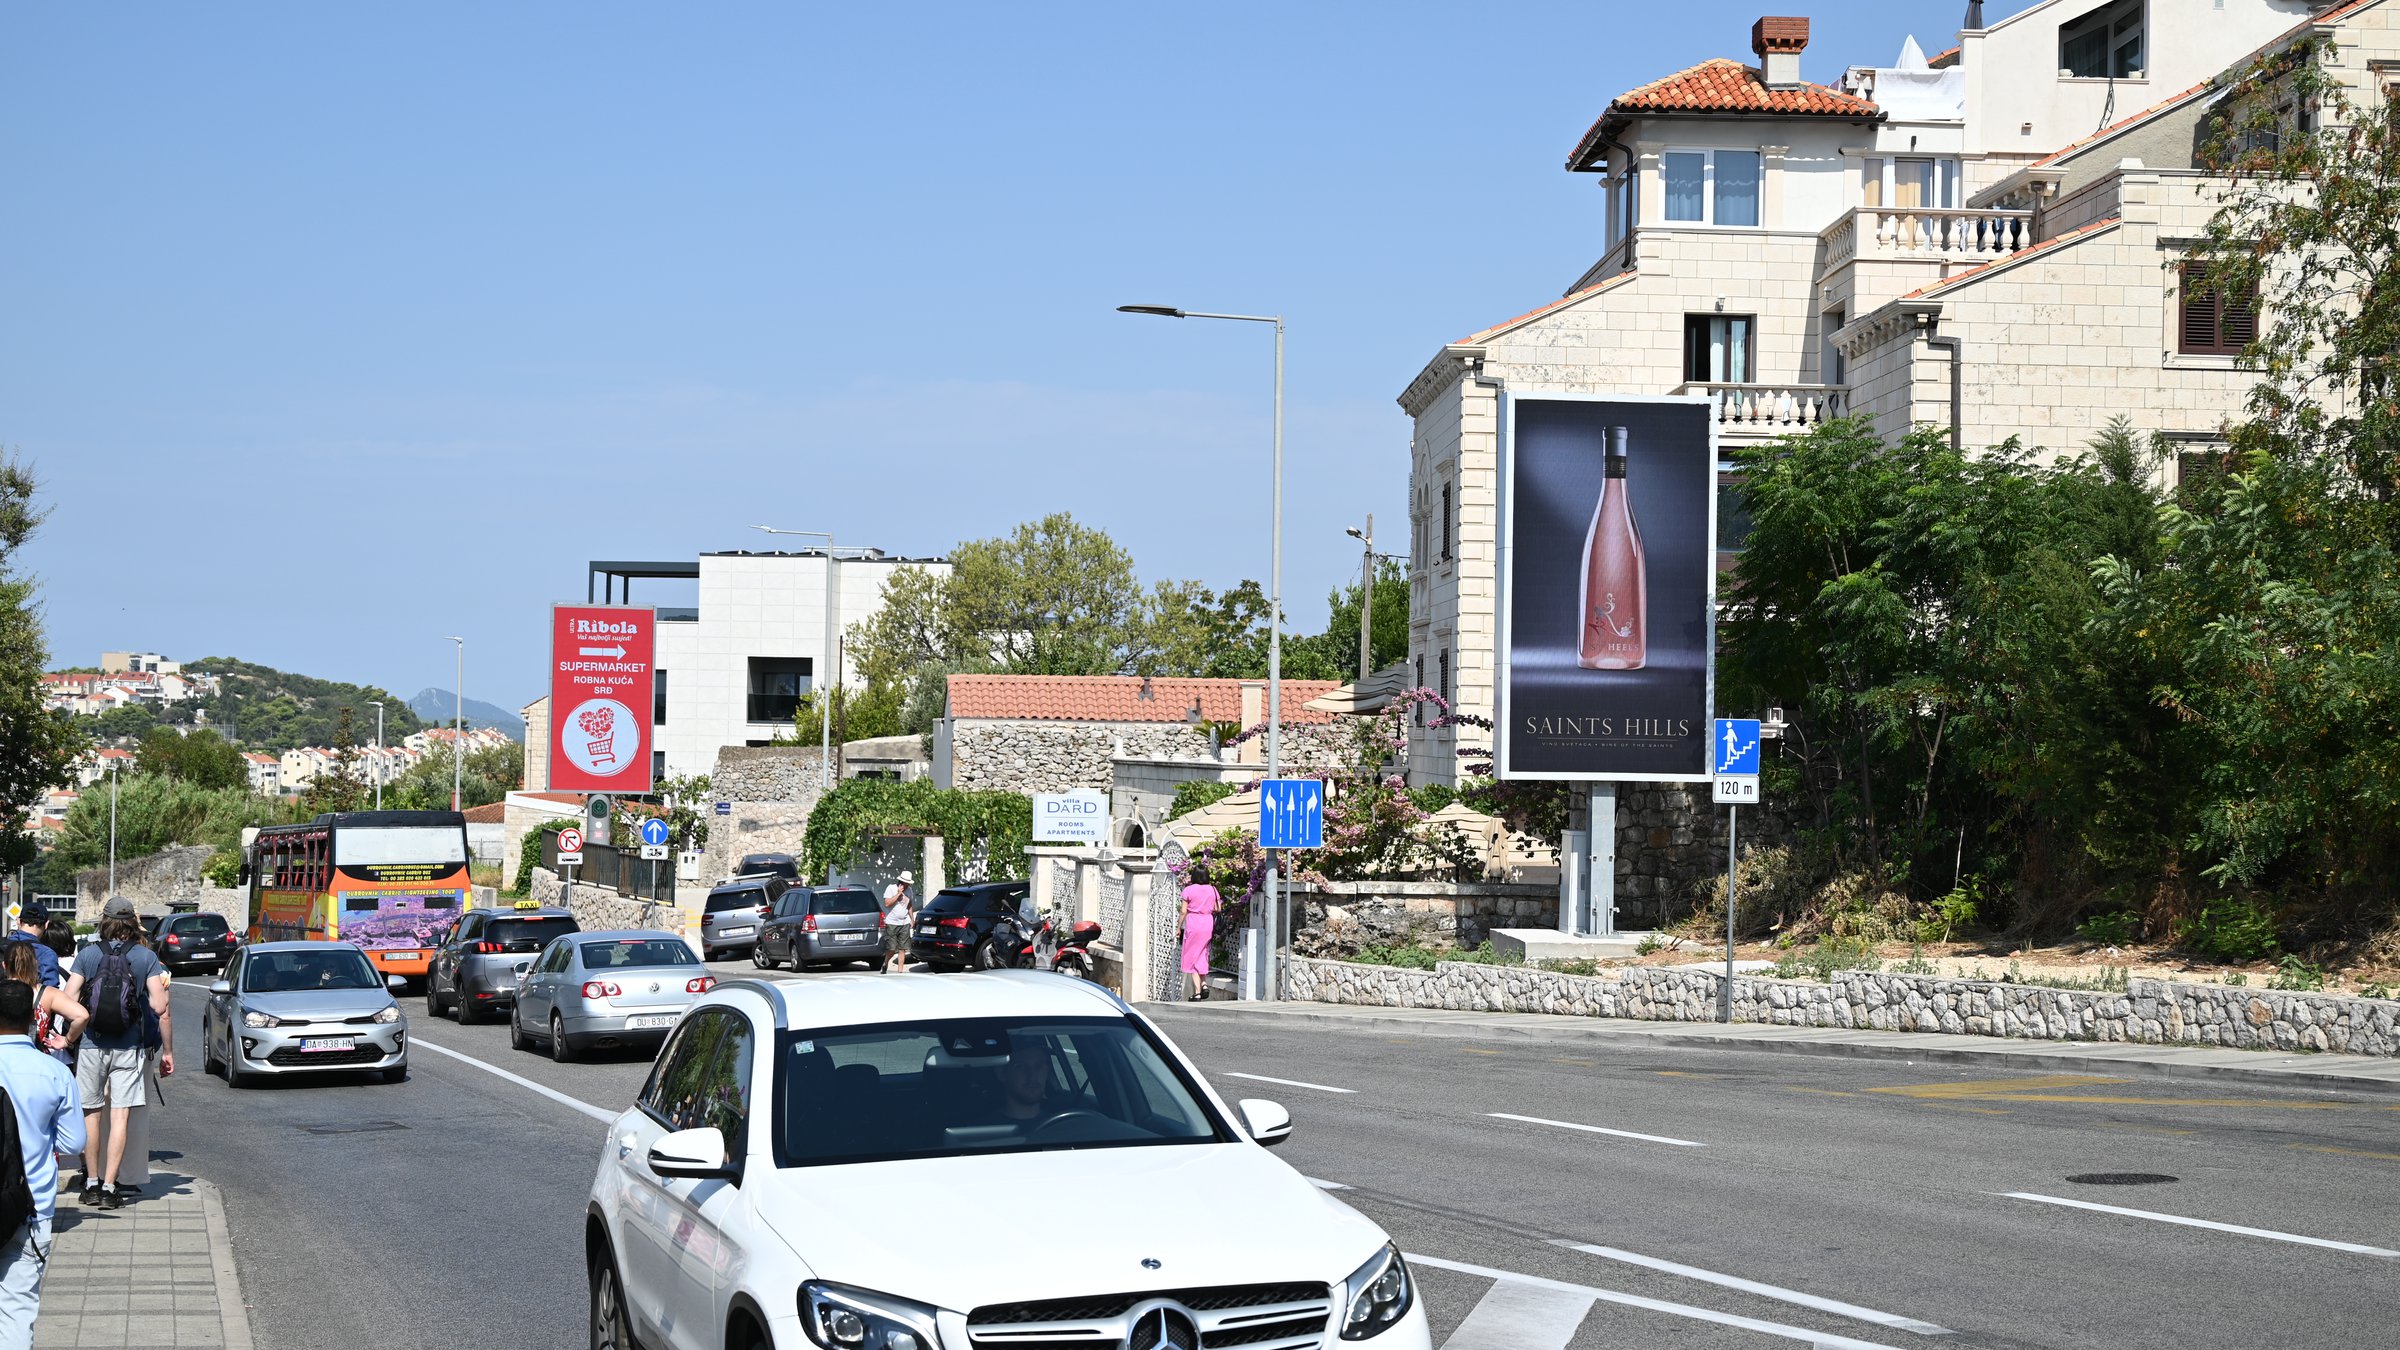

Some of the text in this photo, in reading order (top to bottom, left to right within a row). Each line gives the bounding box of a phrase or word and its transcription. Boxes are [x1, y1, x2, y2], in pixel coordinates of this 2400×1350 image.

[560, 661, 646, 673] SUPERMARKET
[573, 675, 634, 685] ROBNA KUĆA
[1526, 716, 1689, 737] SAINTS HILLS
[1721, 781, 1752, 795] 120 m
[637, 1018, 646, 1027] DU
[306, 1040, 317, 1049] DA
